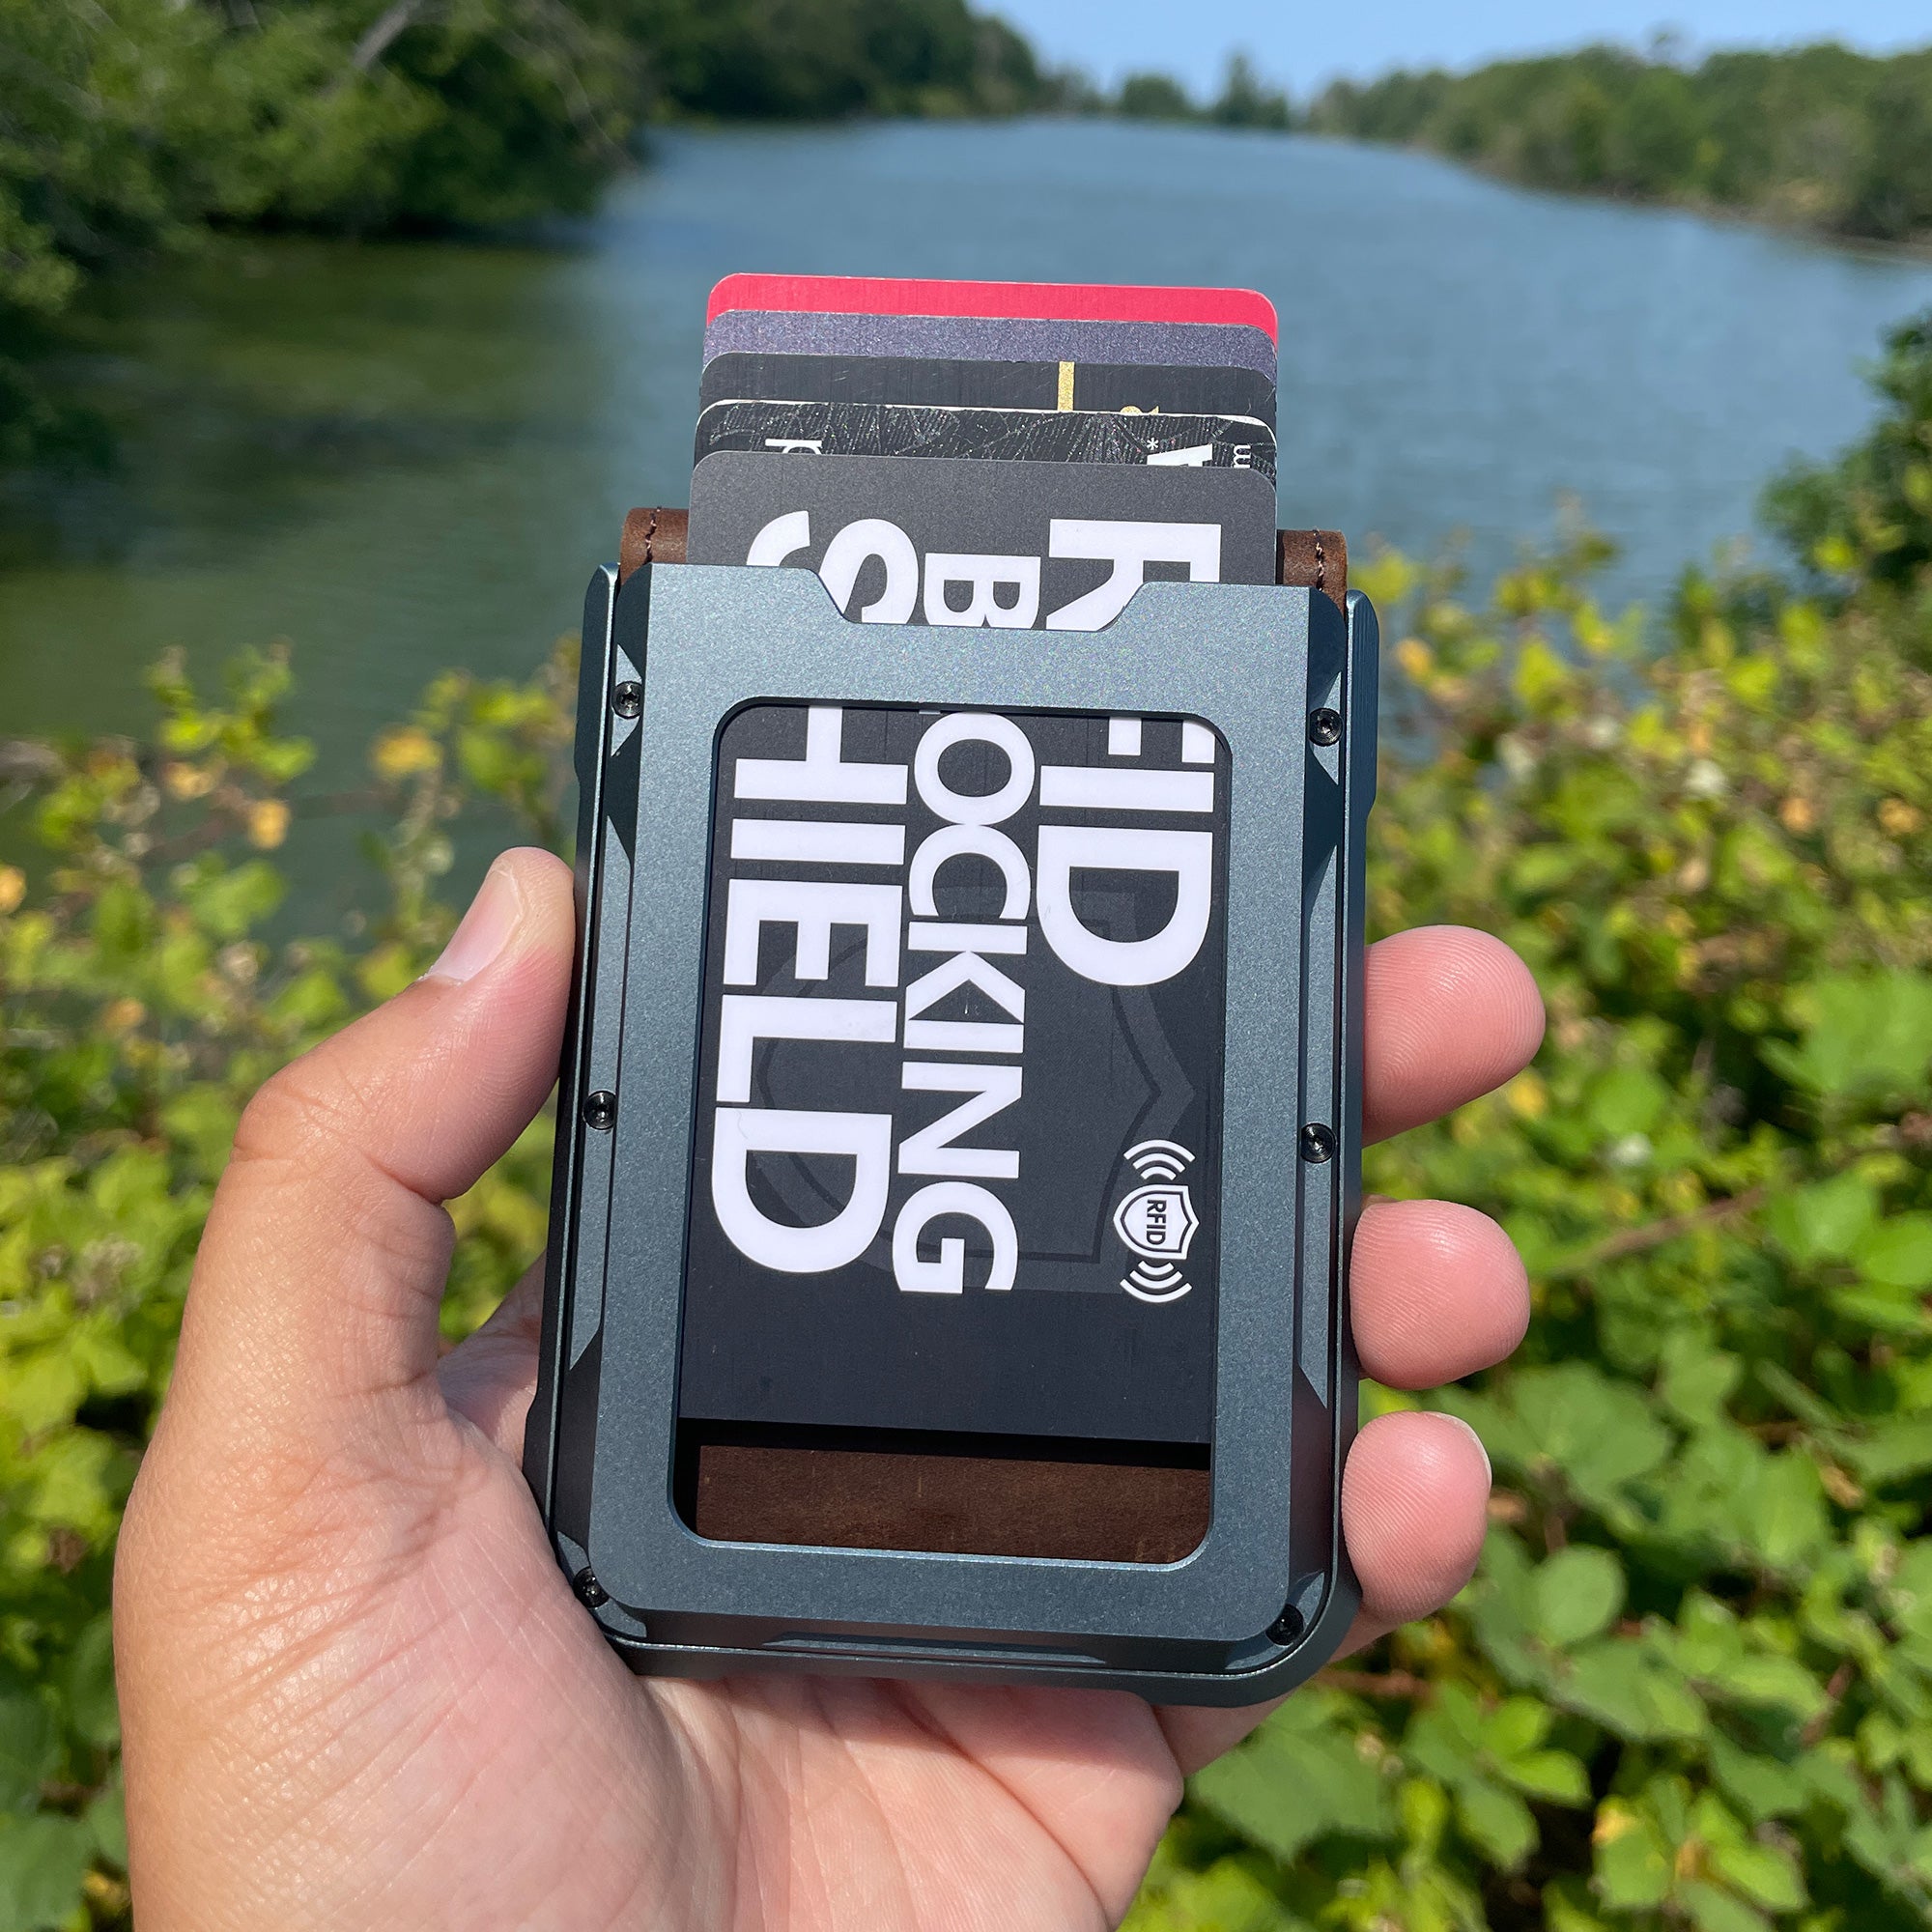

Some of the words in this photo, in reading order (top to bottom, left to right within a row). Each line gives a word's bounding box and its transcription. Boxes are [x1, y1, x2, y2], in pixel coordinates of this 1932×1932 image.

[892, 552, 1041, 1294] BOCKING
[1036, 518, 1222, 987] RID
[1146, 1199, 1167, 1246] RFID
